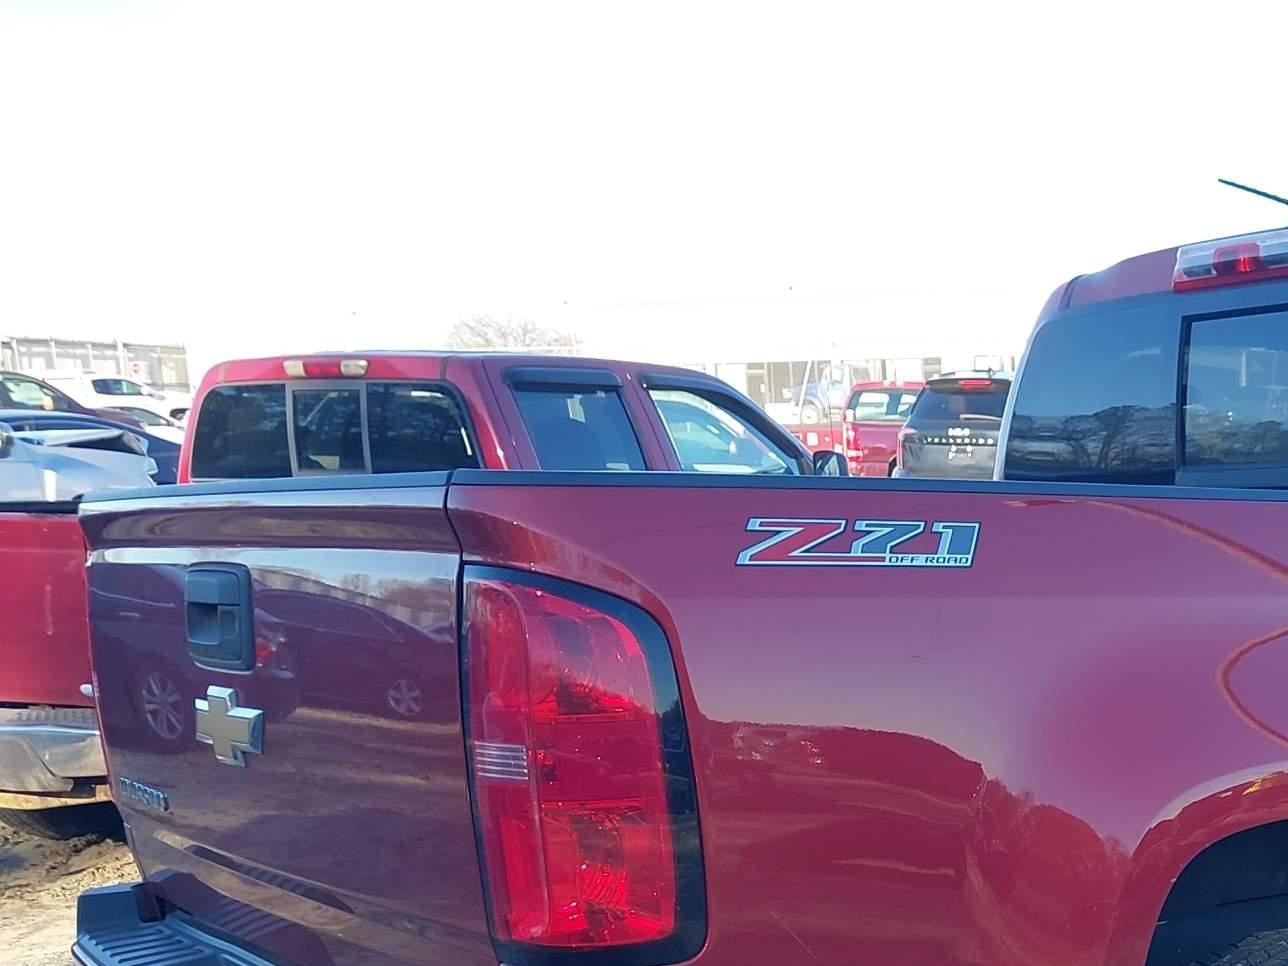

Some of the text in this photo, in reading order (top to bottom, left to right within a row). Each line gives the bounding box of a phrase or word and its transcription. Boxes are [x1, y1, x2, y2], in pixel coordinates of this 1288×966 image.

[736, 517, 981, 568] Z71
[888, 555, 969, 565] OFF ROAD
